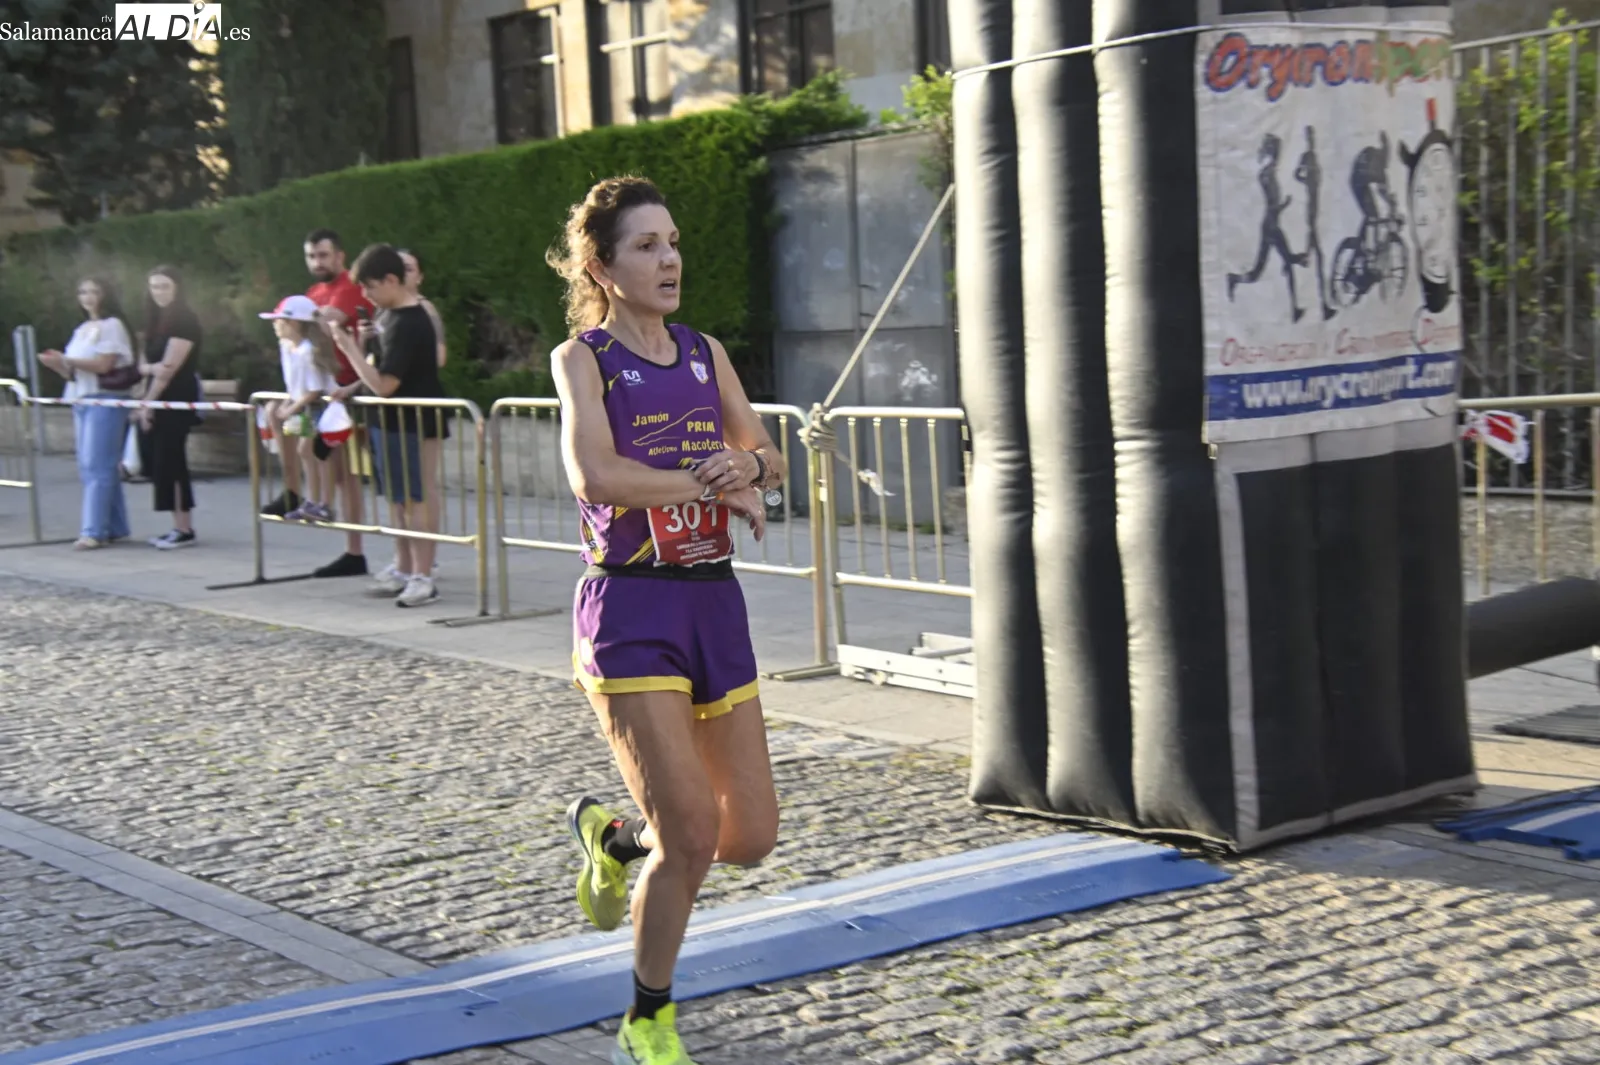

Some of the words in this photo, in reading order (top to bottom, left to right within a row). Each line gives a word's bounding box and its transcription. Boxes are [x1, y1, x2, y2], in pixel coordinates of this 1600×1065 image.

[632, 411, 669, 427] Jamón
[686, 421, 716, 433] PRIM
[648, 446, 678, 456] Atletismo
[662, 500, 718, 533] 301
